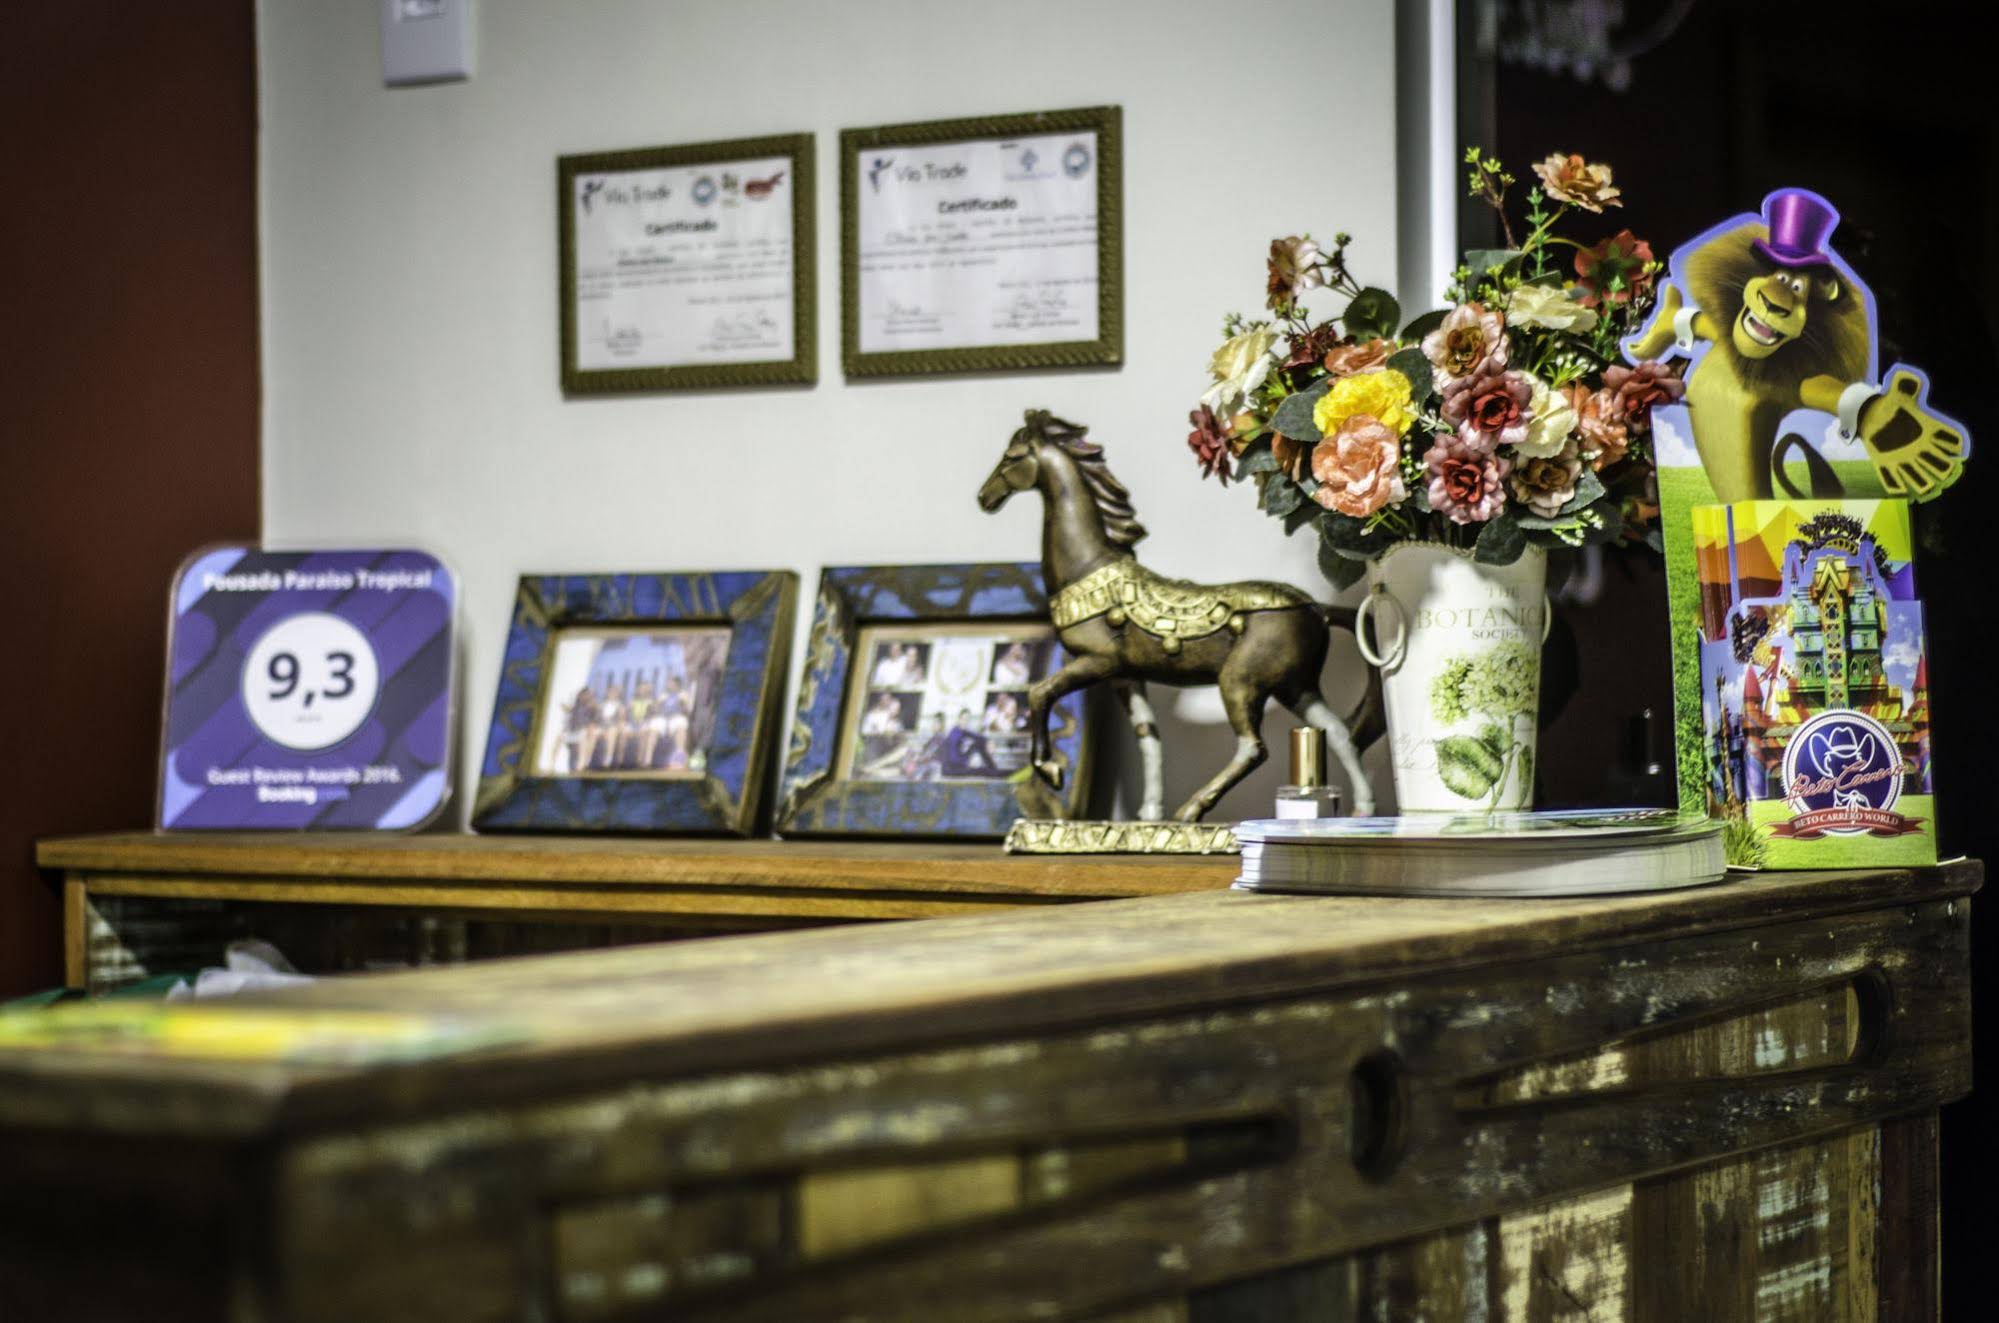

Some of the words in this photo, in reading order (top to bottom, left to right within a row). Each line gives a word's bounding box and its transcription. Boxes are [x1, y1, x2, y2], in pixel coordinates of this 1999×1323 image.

[938, 196, 1018, 214] Certificado
[203, 572, 282, 592] Pousada
[355, 567, 433, 593] Tropical
[266, 650, 357, 709] 9,3
[206, 766, 251, 785] Guest
[253, 765, 304, 784] Review
[306, 765, 361, 784] Awards
[1794, 816, 1820, 829] BETO
[1819, 811, 1863, 823] CARRERO
[1863, 812, 1899, 825] WORLD
